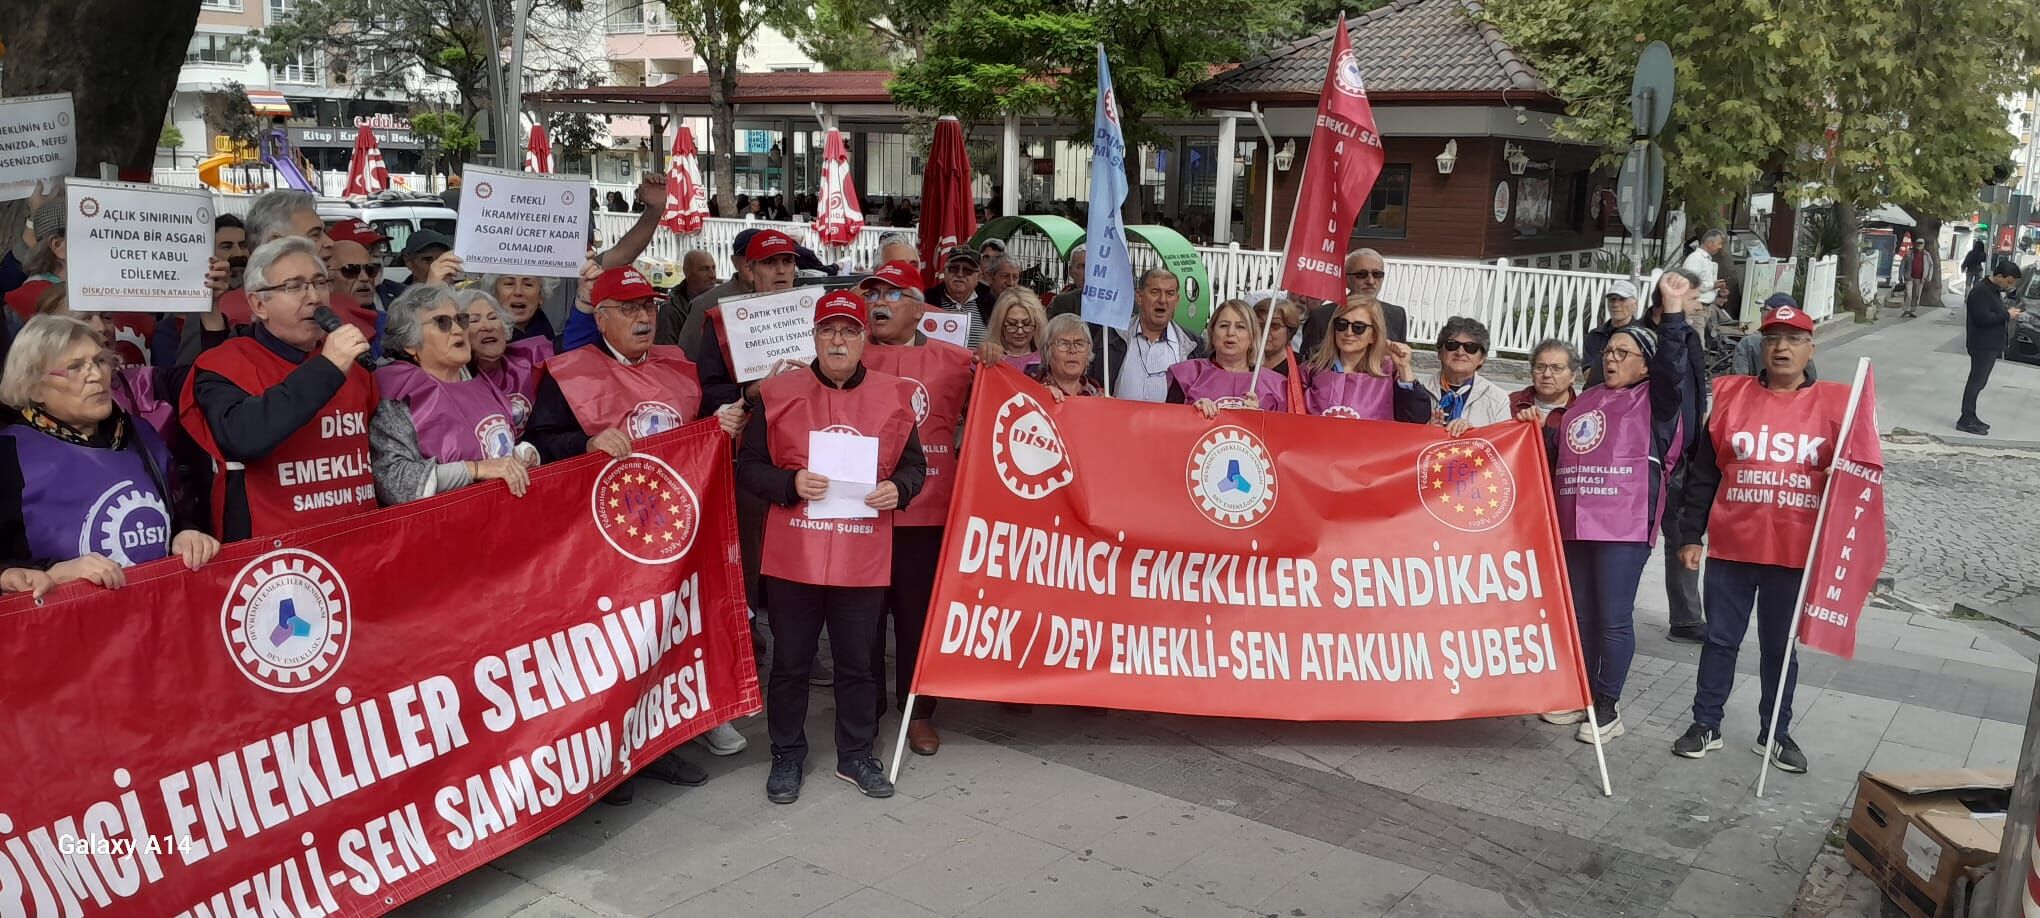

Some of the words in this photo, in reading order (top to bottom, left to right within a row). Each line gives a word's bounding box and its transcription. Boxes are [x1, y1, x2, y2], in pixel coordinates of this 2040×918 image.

[41, 135, 68, 147] NEFESİ
[303, 130, 332, 142] Kitap
[510, 193, 546, 206] EMEKLİ
[103, 209, 136, 222] AÇLIK
[140, 211, 193, 225] SINIRININ
[481, 206, 551, 224] İKRAMİYELERİ
[552, 213, 566, 224] EN
[567, 215, 578, 225] AZ
[89, 228, 140, 241] ALTINDA
[143, 229, 162, 243] BİR
[165, 232, 206, 245] ASGARİ
[474, 223, 513, 236] ASGARİ
[516, 225, 548, 239] ÜCRET
[549, 229, 580, 240] KADAR
[110, 246, 147, 261] ÜCRET
[151, 250, 188, 262] KABUL
[498, 241, 555, 254] OLMALIDIR.
[120, 266, 181, 281] EDİLEMEZ.
[749, 310, 771, 320] ARTIK
[745, 335, 785, 349] EMEKLİLER
[321, 409, 366, 439] DİSK
[1731, 424, 1826, 467] DİSK
[603, 461, 642, 486] Européenne
[656, 468, 681, 496] Retraités
[1736, 468, 1812, 490] EMEKLİ-SEN
[293, 488, 352, 512] SAMSUN
[1579, 485, 1618, 496] ŞUBESİ
[1726, 487, 1774, 504] ATAKUM
[1777, 490, 1820, 509] ŞUBESİ
[599, 486, 612, 529] Fédération
[789, 517, 833, 531] ATAKUM
[837, 523, 873, 534] ŞUBESİ
[1826, 487, 1872, 601] ATAKUM
[958, 514, 1125, 596] DEVRİMCİ
[1130, 538, 1322, 608] EMEKLİLER
[1330, 540, 1543, 609] SENDİKASI
[940, 587, 1022, 662] DİSK
[1018, 612, 1043, 670] /
[1043, 614, 1104, 671] DEV
[1109, 614, 1291, 681] EMEKLİ-SEN
[1300, 632, 1434, 682] ATAKUM
[1440, 608, 1558, 695] ŞUBESİ
[159, 674, 470, 867] EMEKLİLER
[473, 571, 702, 734] SENDİKASI
[173, 802, 438, 918] EKLİ-SEN
[434, 719, 614, 851] SAMSUN
[619, 648, 711, 776] ŞUBESİ
